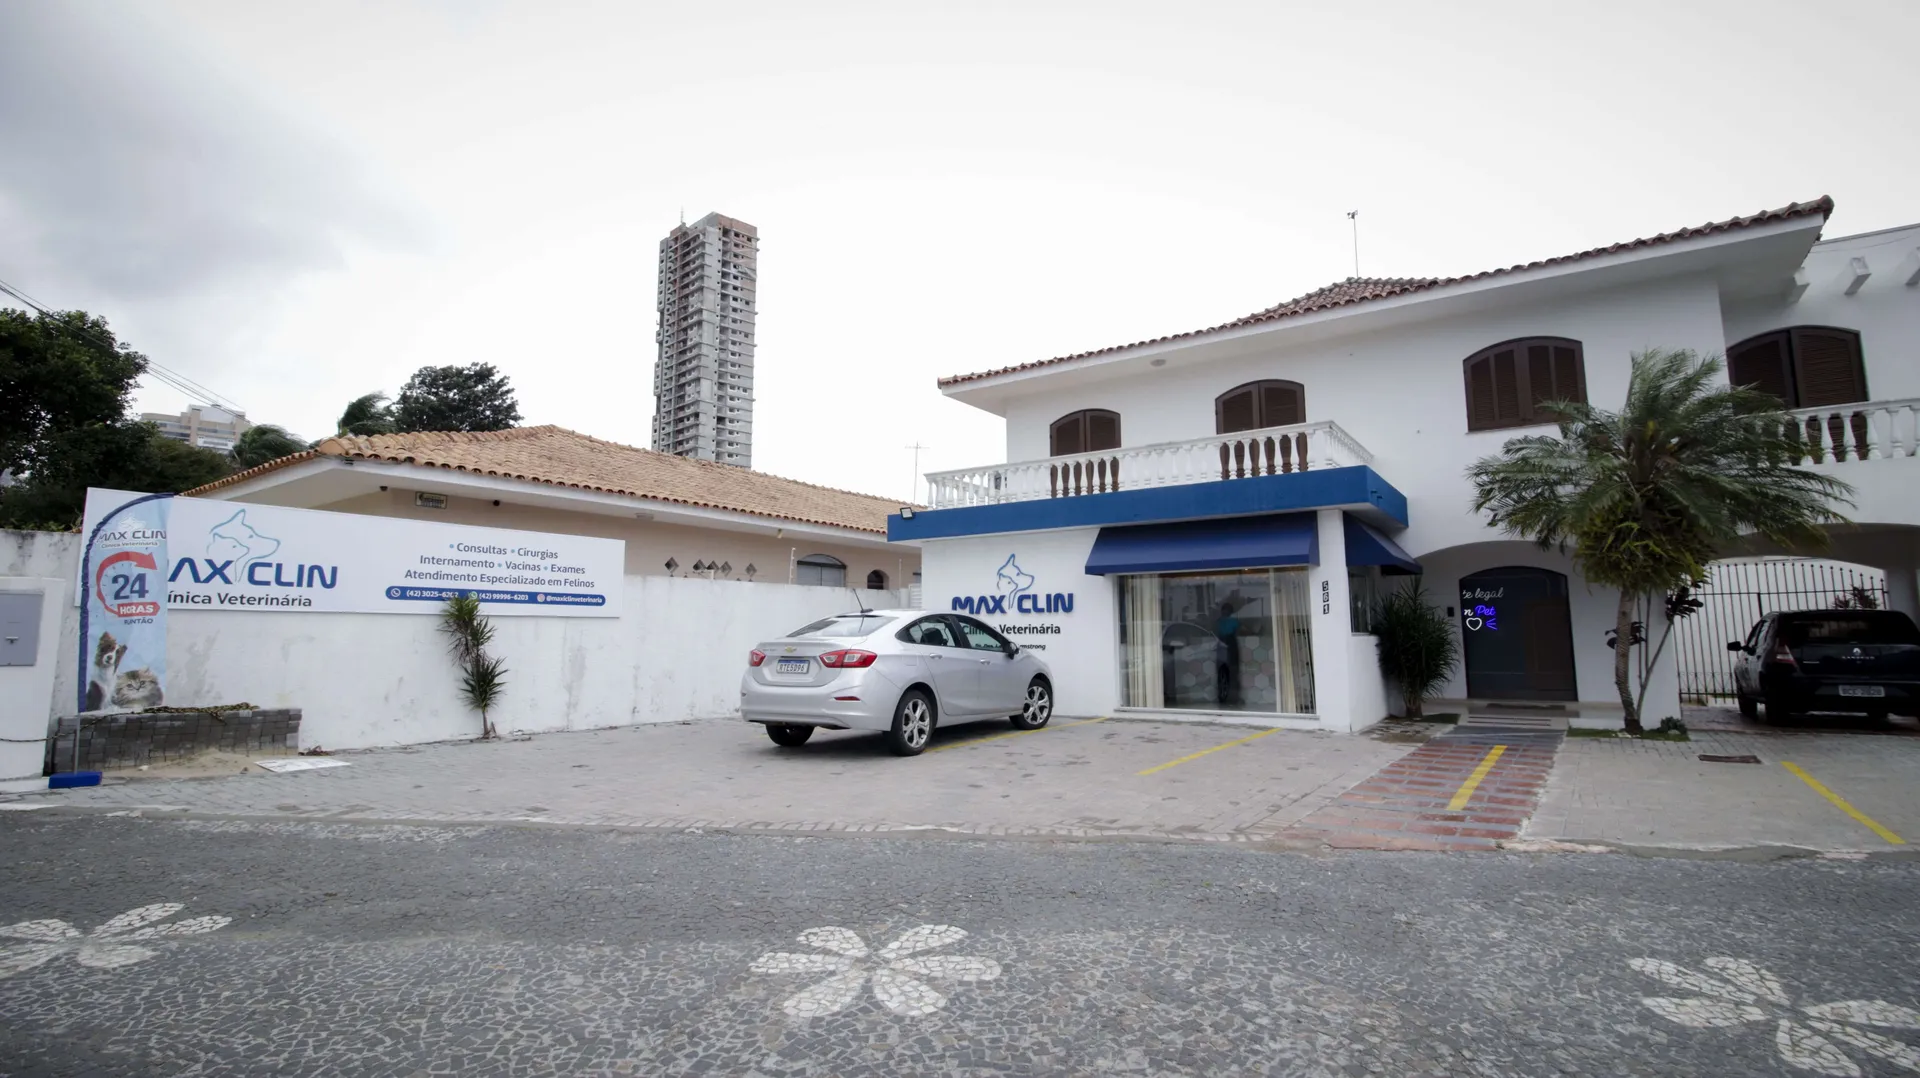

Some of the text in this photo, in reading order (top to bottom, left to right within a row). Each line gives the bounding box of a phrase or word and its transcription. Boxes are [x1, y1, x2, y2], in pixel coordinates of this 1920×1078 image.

[132, 530, 167, 540] CLIN
[457, 542, 559, 560] Consultas Cirurgias
[168, 557, 338, 589] AX CLIN
[420, 555, 586, 575] Internamento Vacinas Exames
[112, 573, 149, 600] 24
[404, 569, 595, 588] Atendimento Especializado em Felinos
[168, 590, 312, 607] ínica Veterinária
[406, 589, 421, 598] (42)
[479, 592, 492, 601] (42)
[1322, 581, 1330, 614] 561
[1475, 587, 1504, 602] legal
[120, 605, 154, 614] HORAS
[951, 593, 1074, 614] MAX CLIN
[1475, 605, 1497, 617] Pet
[999, 623, 1061, 635] Veterinária
[1018, 643, 1046, 651] rmstrong
